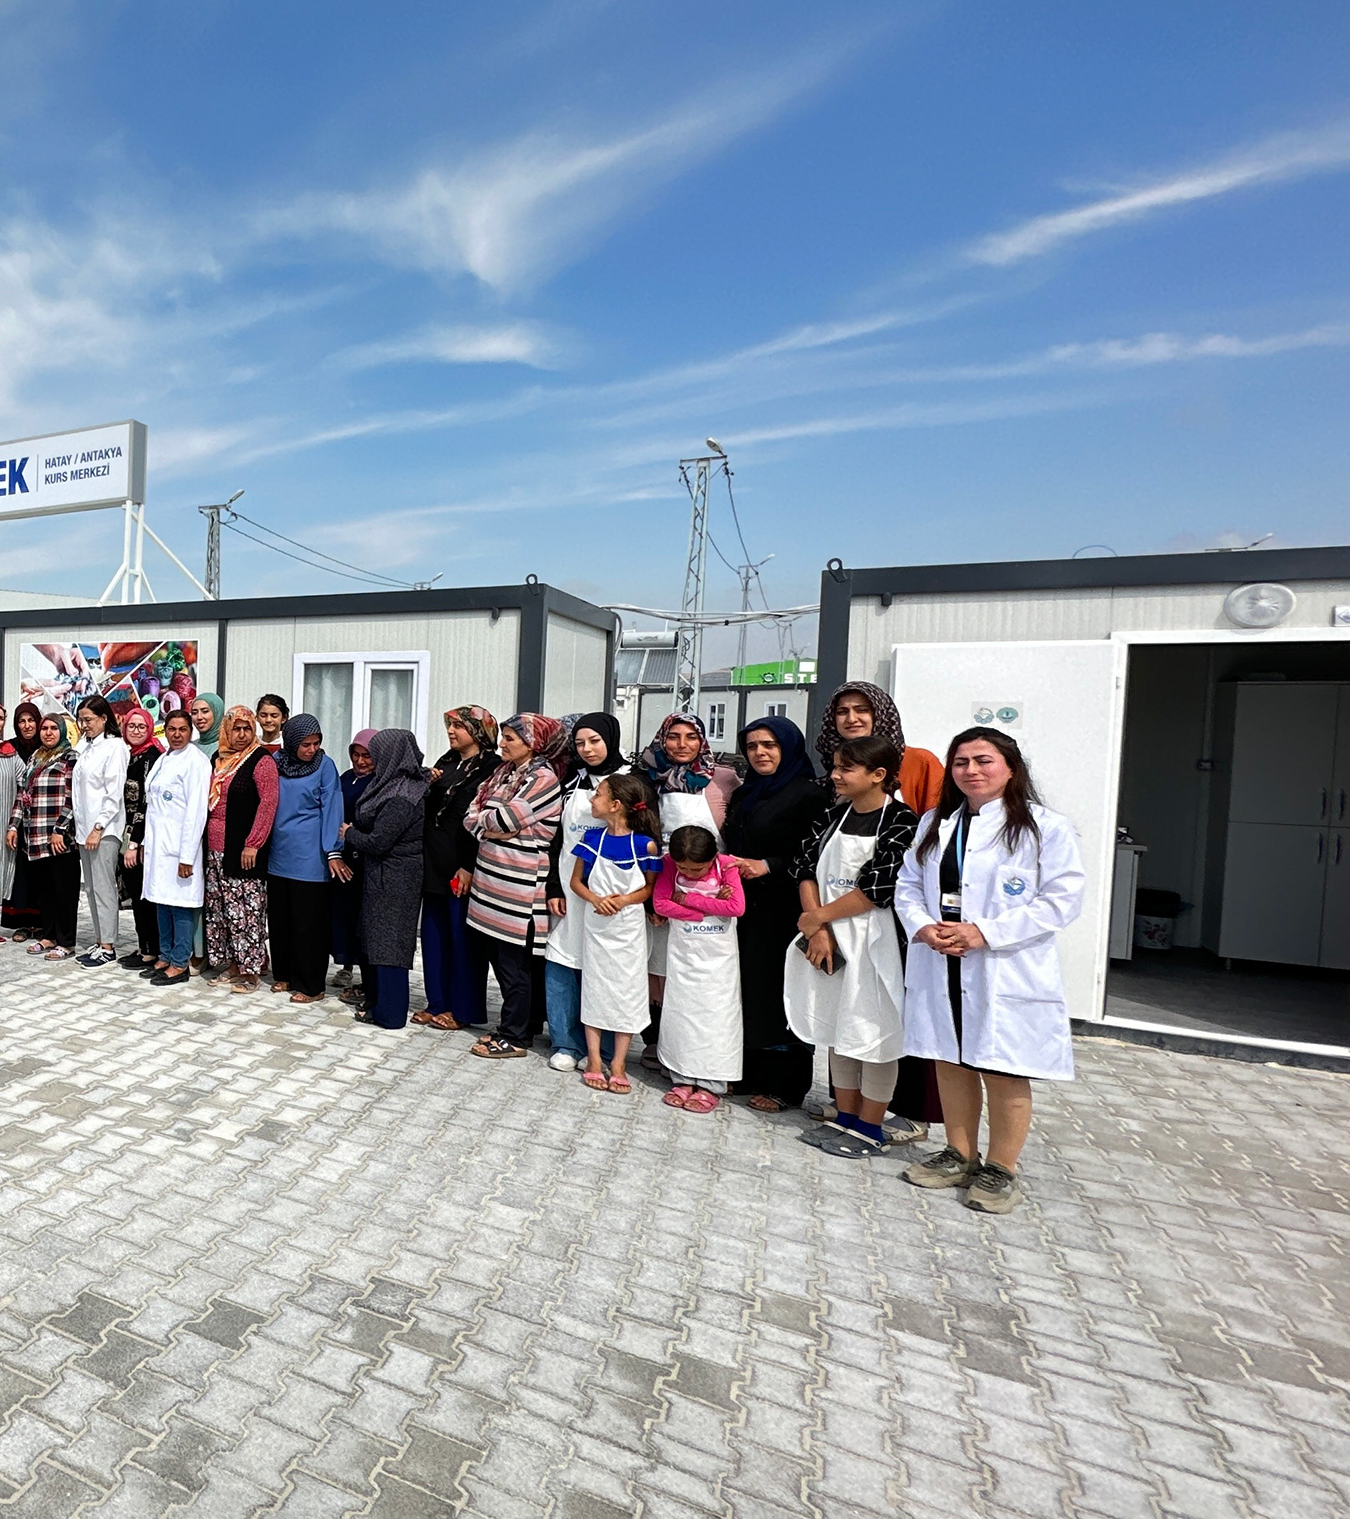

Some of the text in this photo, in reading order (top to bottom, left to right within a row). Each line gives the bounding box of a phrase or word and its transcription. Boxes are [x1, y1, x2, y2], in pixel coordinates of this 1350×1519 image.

[45, 446, 123, 469] HATAY / ANTAKYA
[44, 462, 110, 485] KURS MERKEZİ
